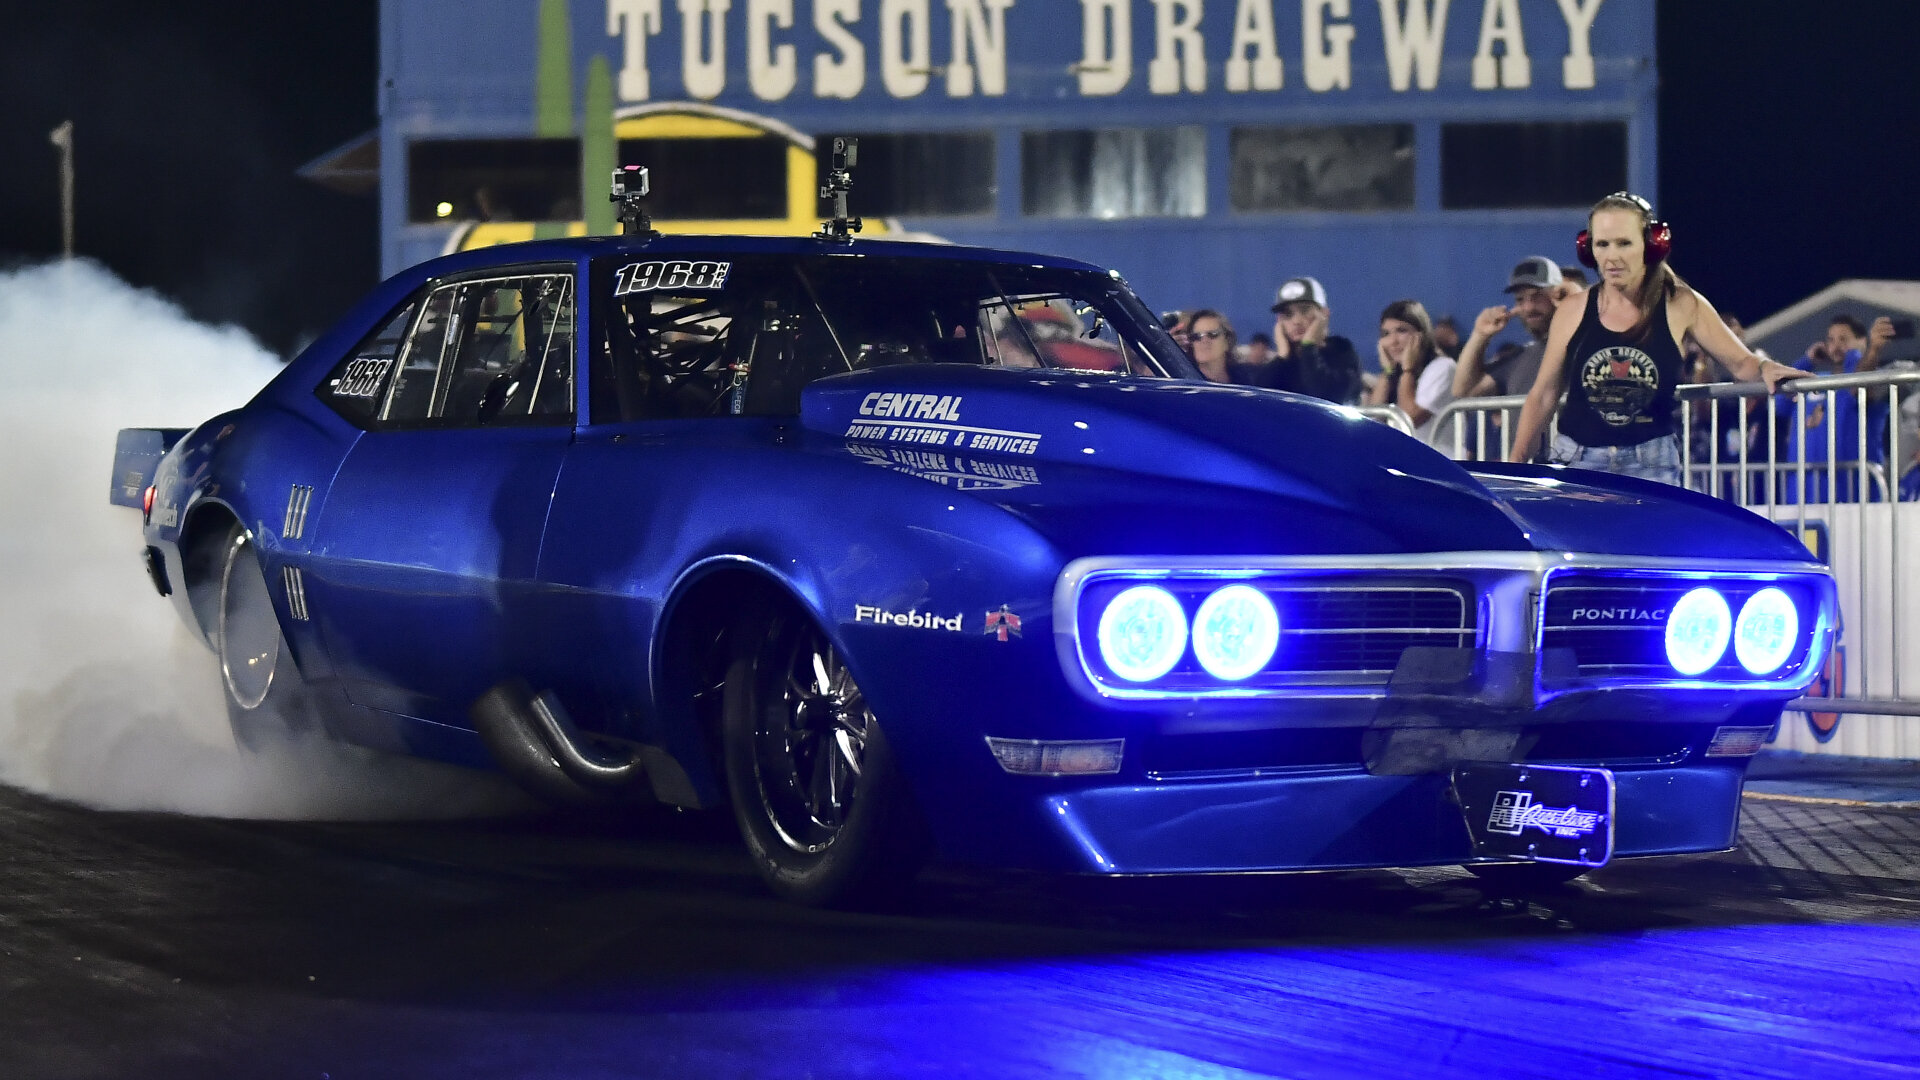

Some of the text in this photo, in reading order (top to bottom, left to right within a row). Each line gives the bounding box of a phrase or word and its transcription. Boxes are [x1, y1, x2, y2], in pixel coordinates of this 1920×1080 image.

[606, 0, 1604, 101] TUCSON DRAGWAY
[614, 260, 719, 295] 1968
[859, 392, 963, 421] CENTRAL
[845, 425, 1039, 455] POWER SYSTEMS & SERVICES
[855, 604, 963, 632] Firebird
[1572, 608, 1666, 621] PONTIAC
